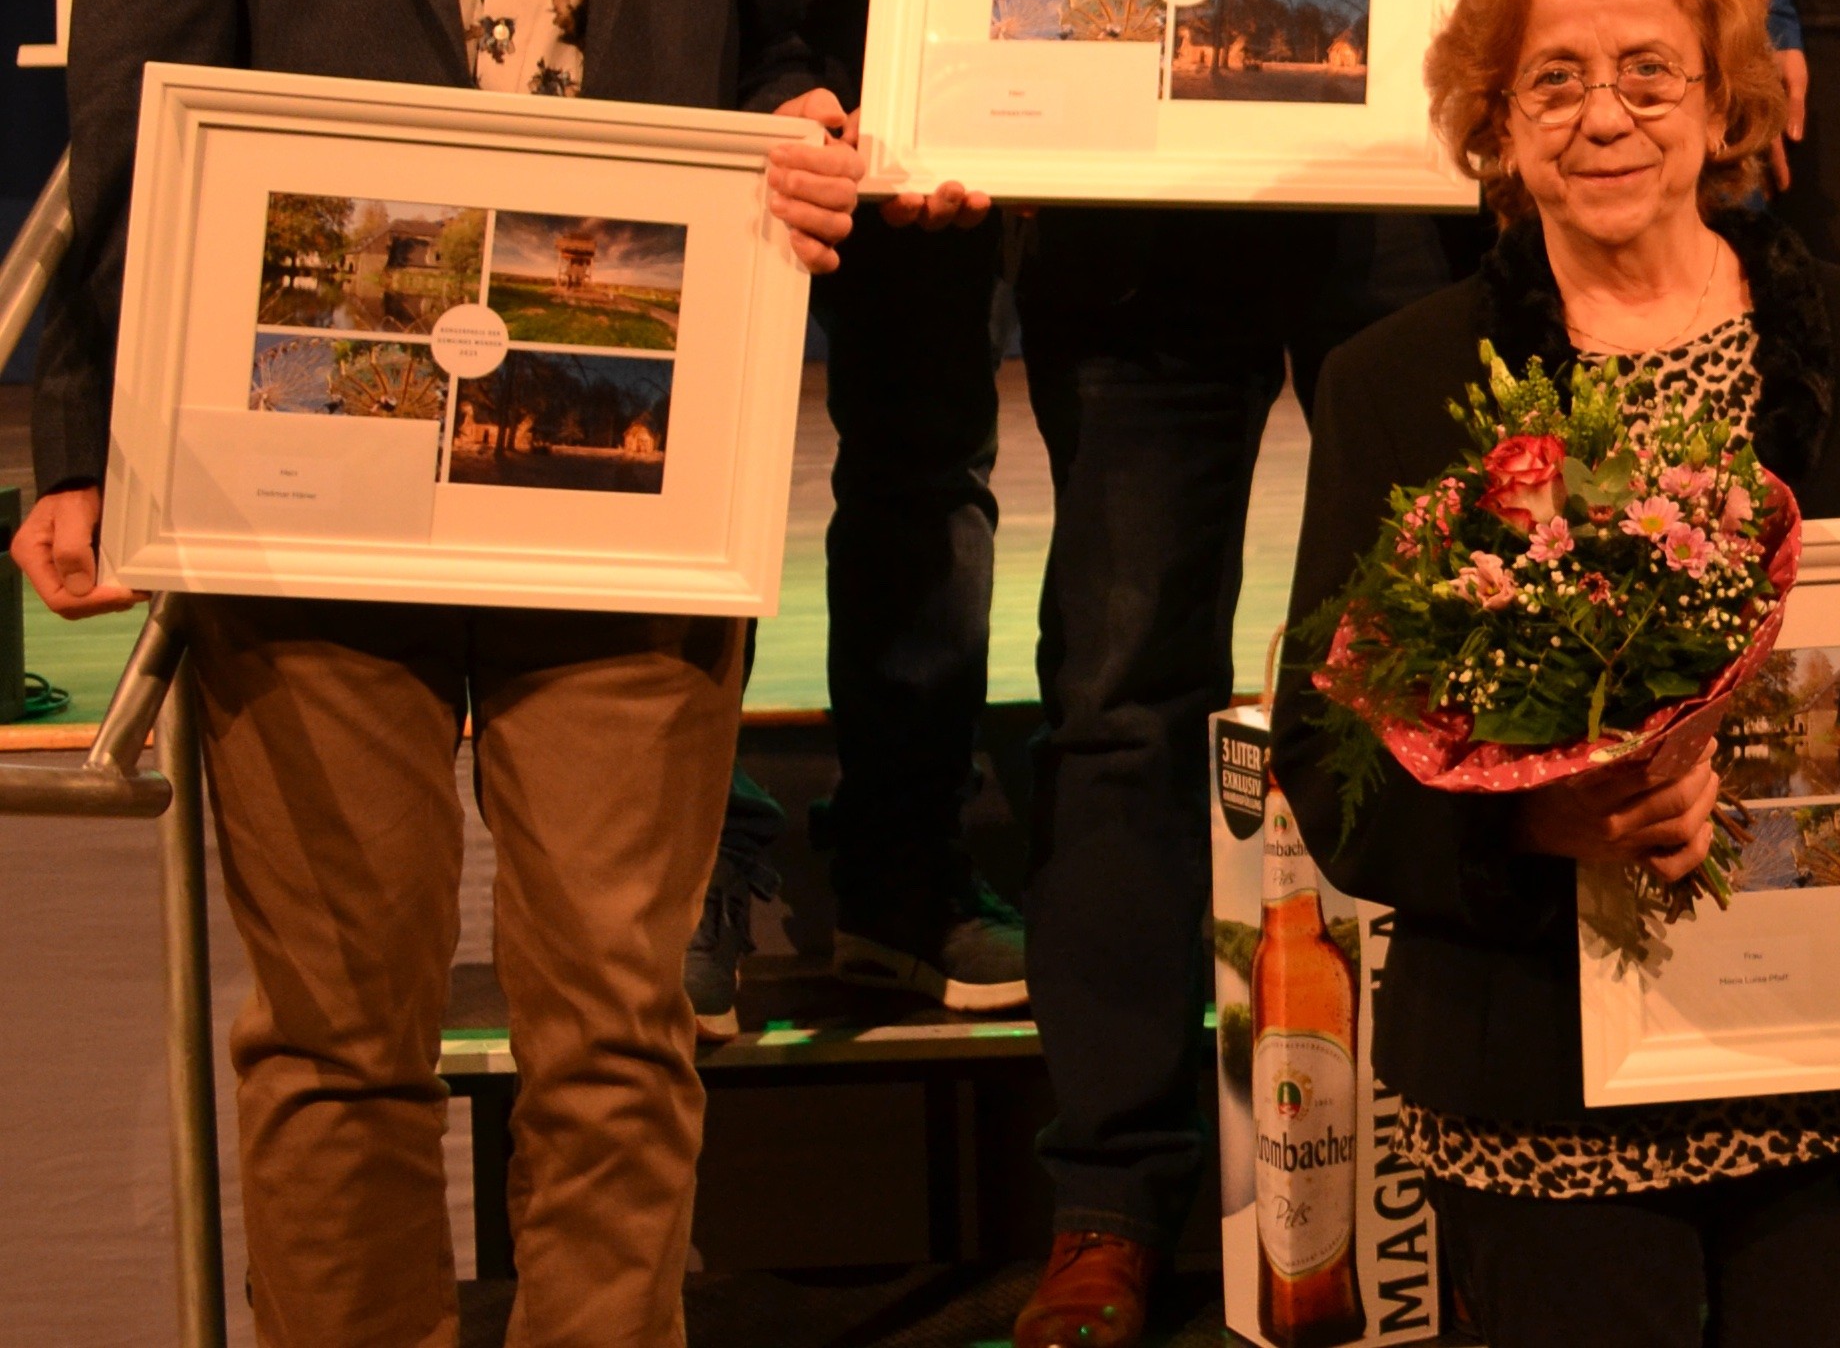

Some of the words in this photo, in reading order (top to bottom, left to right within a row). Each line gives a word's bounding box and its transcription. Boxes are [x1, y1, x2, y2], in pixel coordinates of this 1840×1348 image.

[1222, 737, 1230, 763] 3
[1231, 740, 1261, 772] LITER
[1256, 1125, 1355, 1173] rombacher
